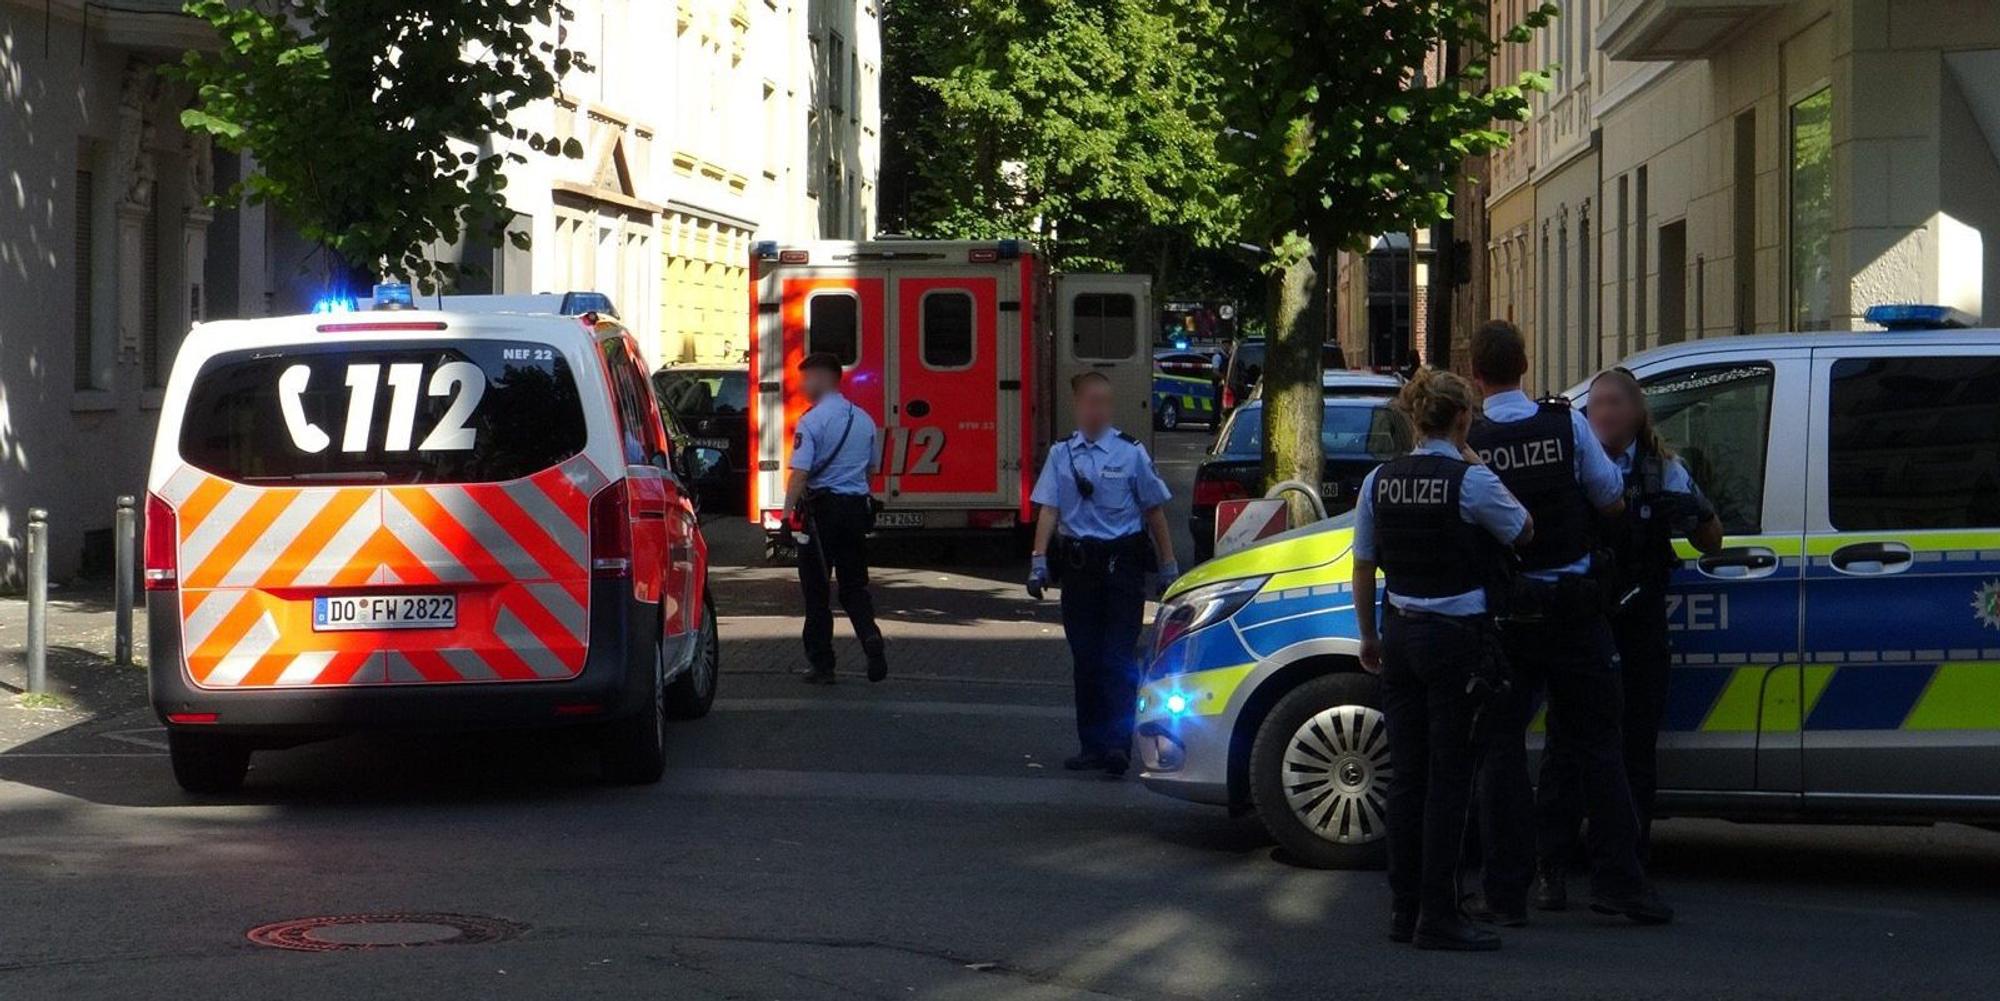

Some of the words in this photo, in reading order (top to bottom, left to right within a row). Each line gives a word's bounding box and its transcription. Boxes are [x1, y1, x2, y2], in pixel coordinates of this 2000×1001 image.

[502, 348, 530, 360] NEF
[532, 348, 552, 360] 22
[342, 361, 487, 452] 112
[870, 425, 945, 475] 112
[1478, 437, 1563, 470] POLIZEI
[1377, 478, 1449, 503] POLIZEI
[331, 600, 356, 622] DO
[372, 599, 397, 621] FW
[403, 598, 454, 620] 2822
[1665, 593, 1729, 631] ZEI
